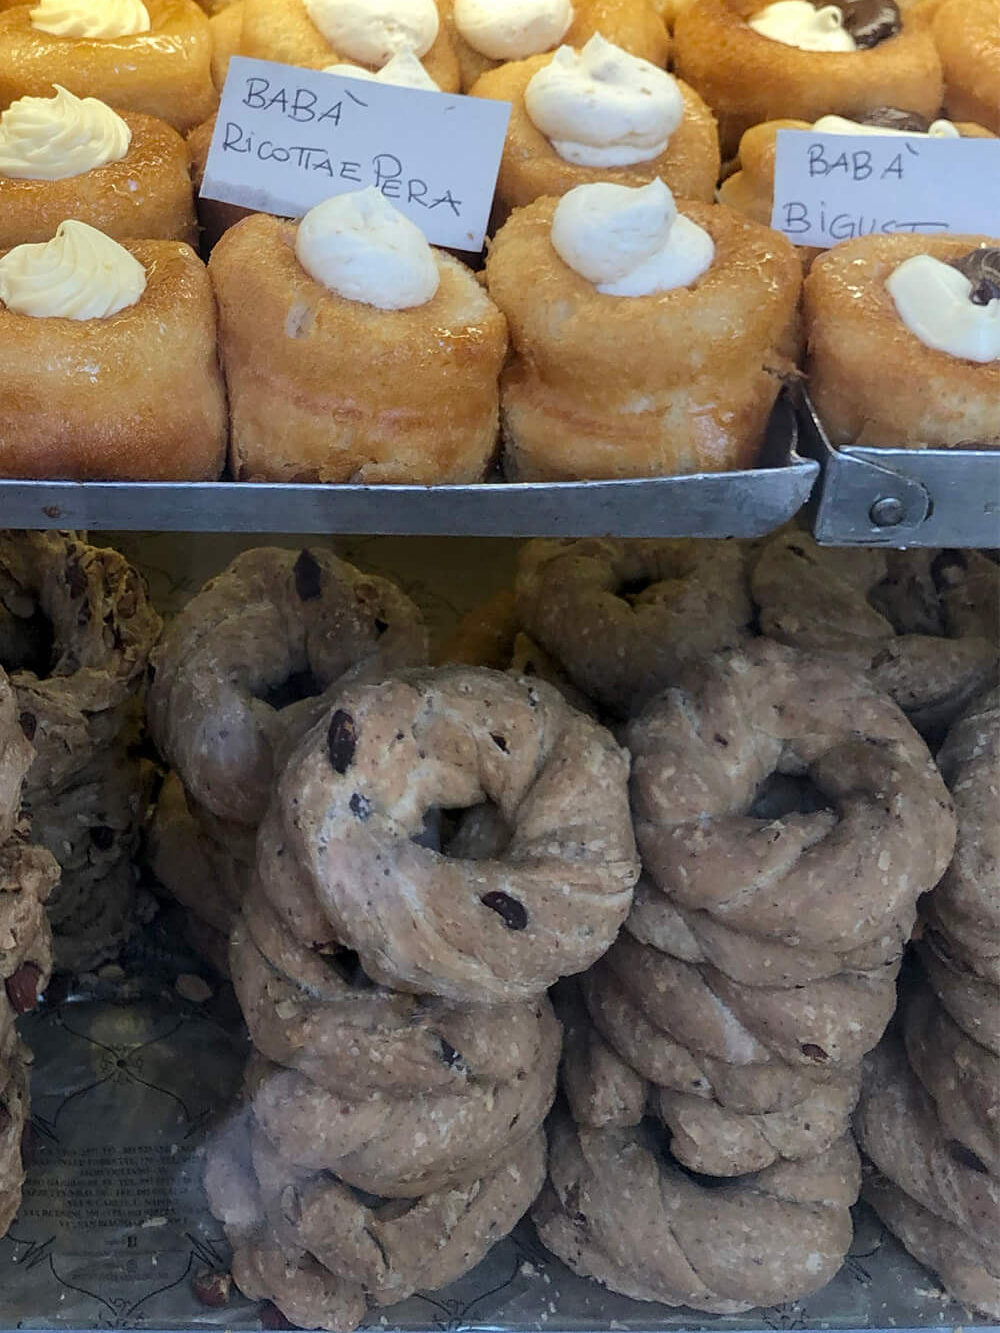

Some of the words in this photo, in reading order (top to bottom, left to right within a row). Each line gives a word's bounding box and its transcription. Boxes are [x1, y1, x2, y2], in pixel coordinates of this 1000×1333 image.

[242, 77, 369, 127] BABÀ
[373, 153, 463, 217] PERA
[806, 141, 920, 181] BABÀ
